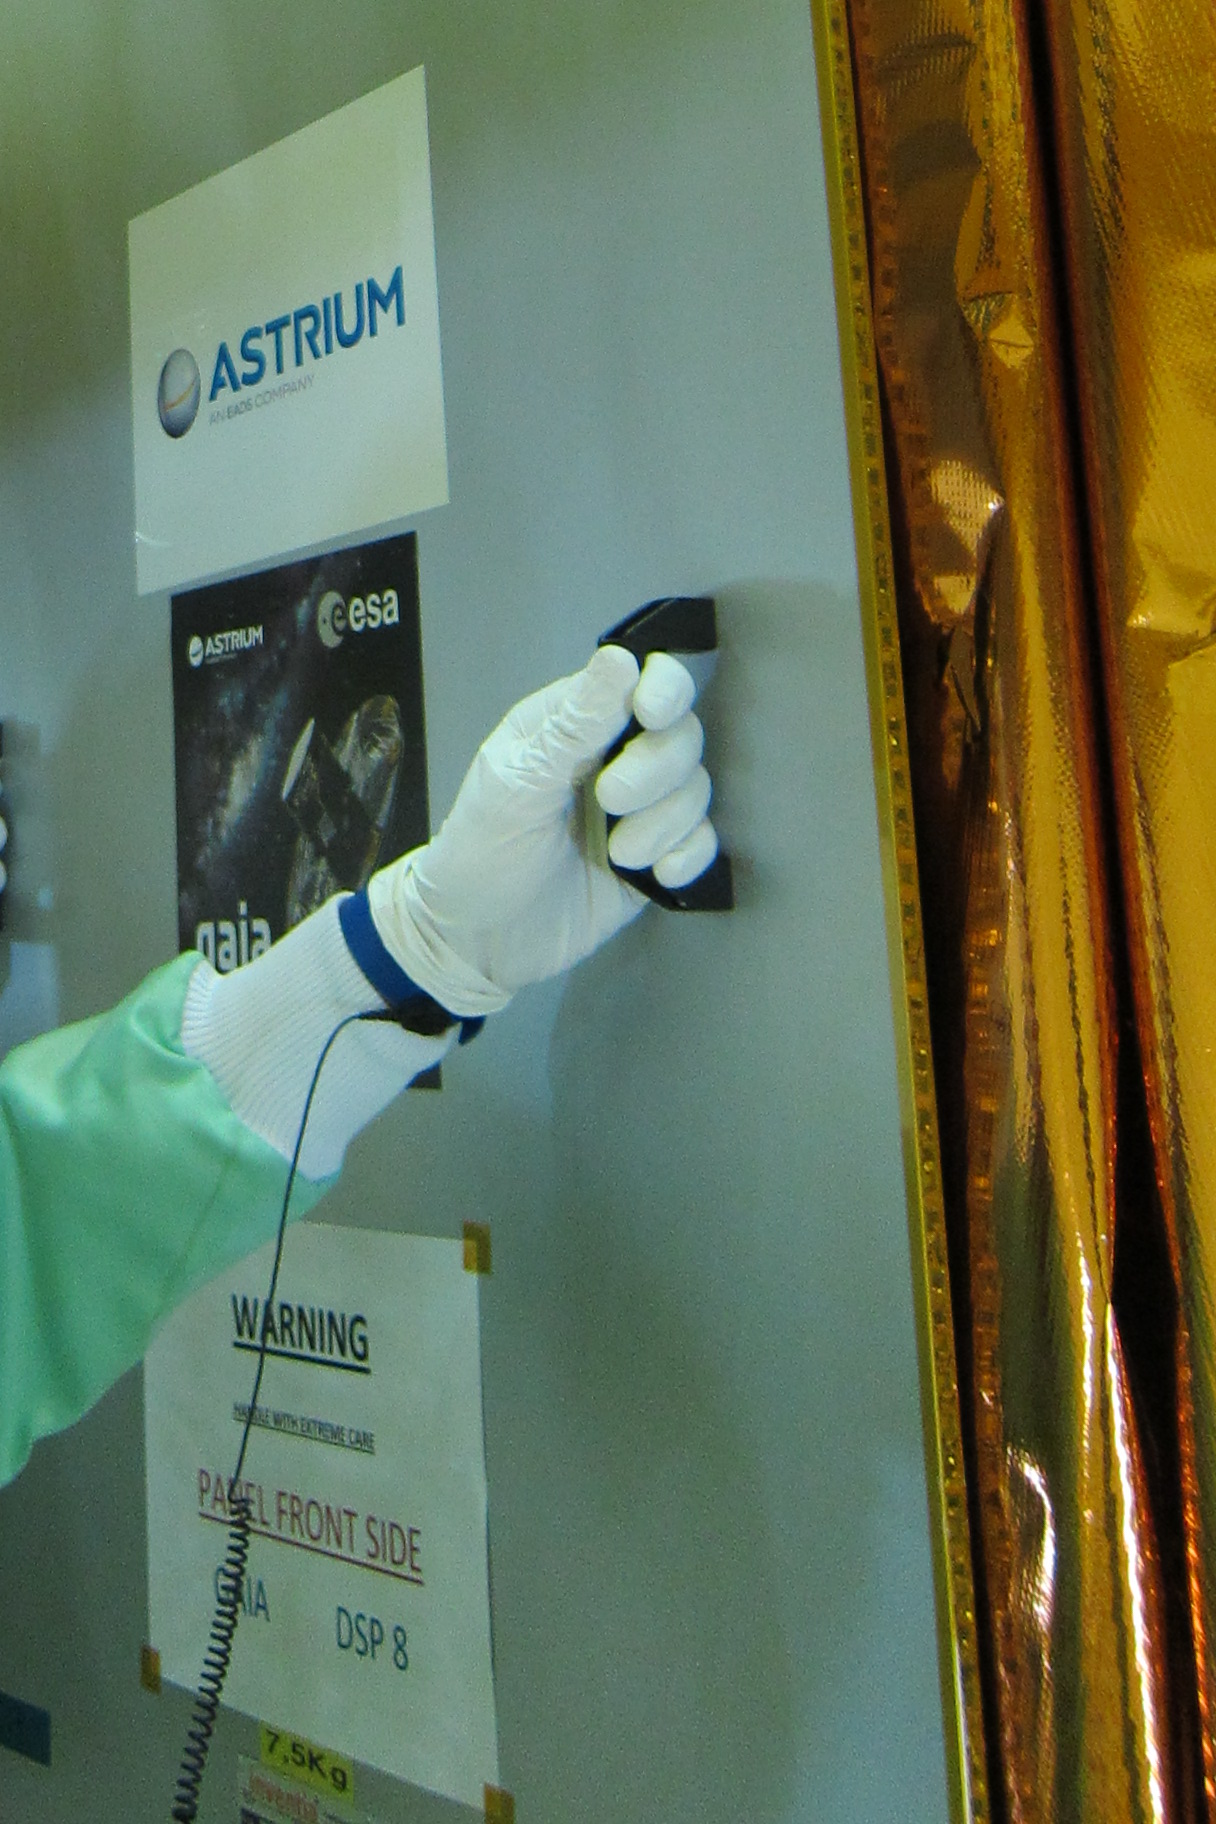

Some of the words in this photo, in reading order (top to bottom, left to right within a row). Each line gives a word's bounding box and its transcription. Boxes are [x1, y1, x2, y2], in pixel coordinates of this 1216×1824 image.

[209, 264, 405, 402] ASTRIUM
[226, 396, 254, 419] EADS
[255, 374, 314, 408] COMPANY
[349, 588, 399, 632] esa
[205, 624, 263, 656] ASTRIUM
[231, 1293, 370, 1362] WARNING
[273, 1409, 299, 1428] WITH
[300, 1415, 346, 1443] EXTREME
[348, 1427, 375, 1451] CARE
[275, 1489, 359, 1553] FRONT
[365, 1514, 422, 1573] SIDE
[336, 1605, 384, 1660] DSP
[392, 1625, 409, 1672] 8
